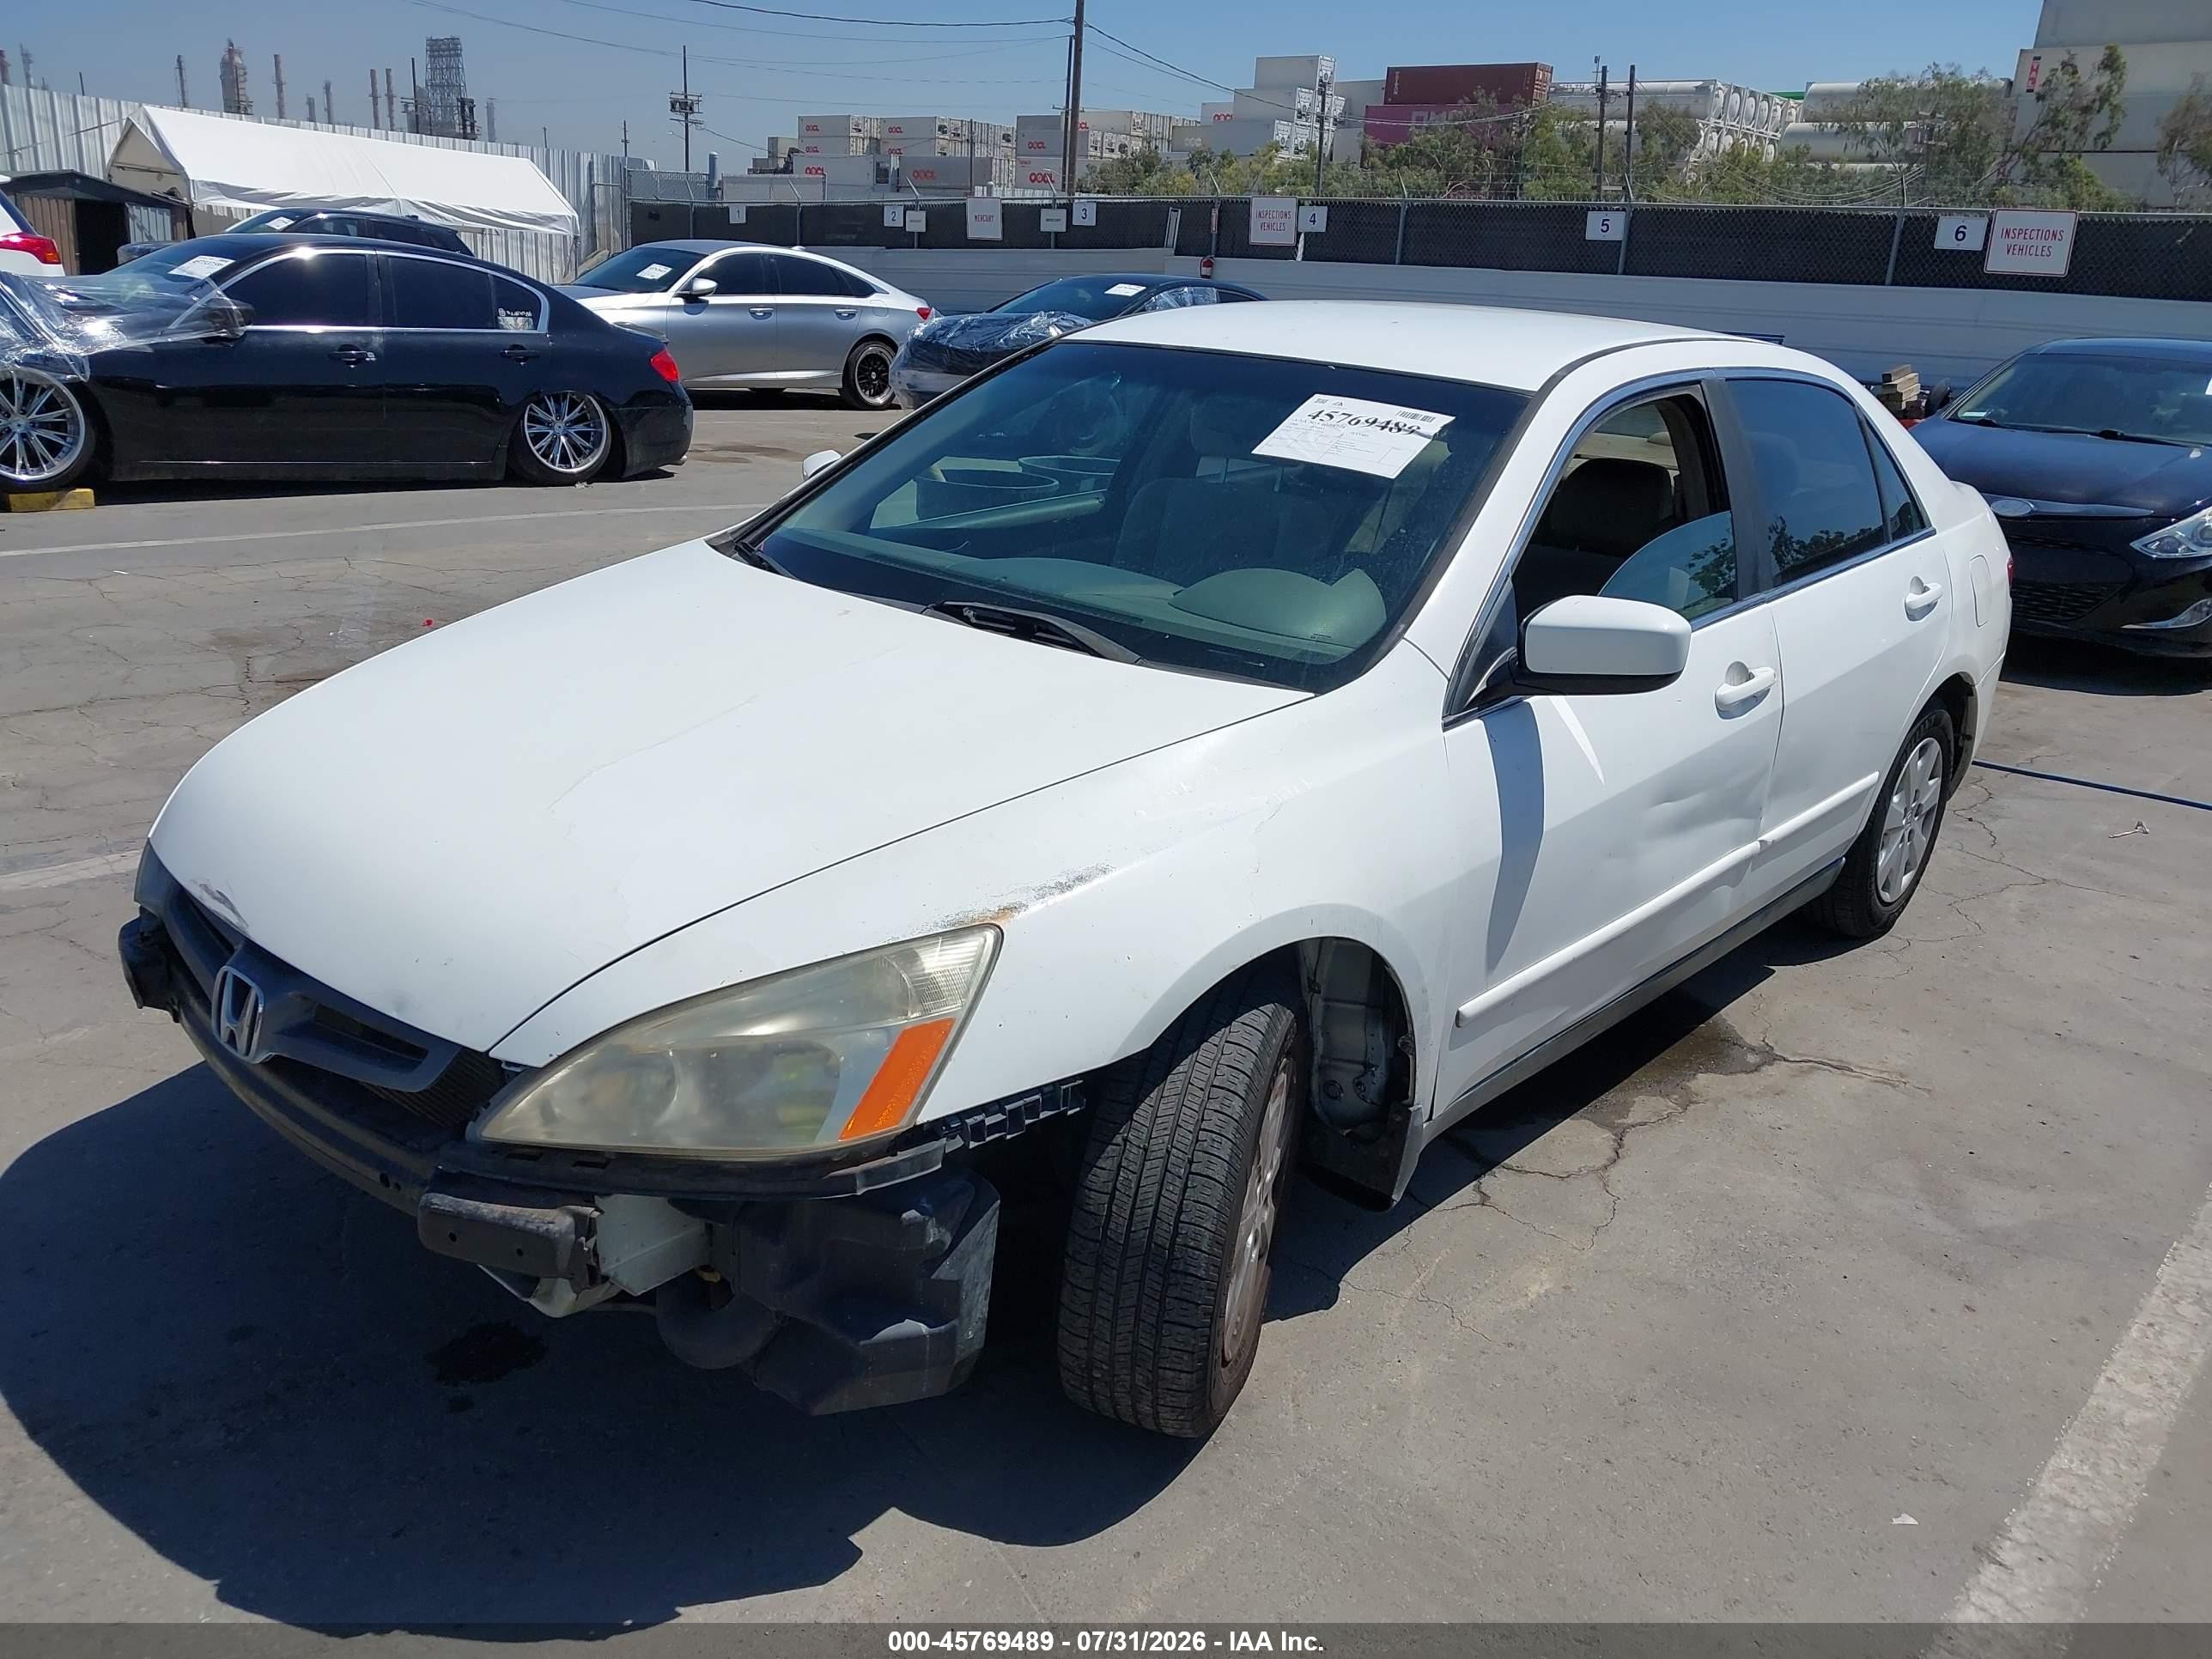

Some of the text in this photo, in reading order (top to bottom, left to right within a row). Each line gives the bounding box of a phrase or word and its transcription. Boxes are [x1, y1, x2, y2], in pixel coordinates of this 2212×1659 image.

[1028, 141, 1047, 149] OOCL
[890, 211, 896, 222] 2
[974, 214, 994, 222] MERCURY
[1081, 208, 1087, 220] 3
[1255, 210, 1291, 220] INSPECTIONS
[1309, 212, 1317, 225] 4
[1260, 222, 1286, 232] VEHICLES
[1600, 218, 1611, 234] 5
[1954, 225, 1967, 241] 6
[2001, 228, 2064, 241] INSPECTIONS
[2006, 244, 2052, 258] VEHICLES
[1307, 409, 1422, 435] 45769489
